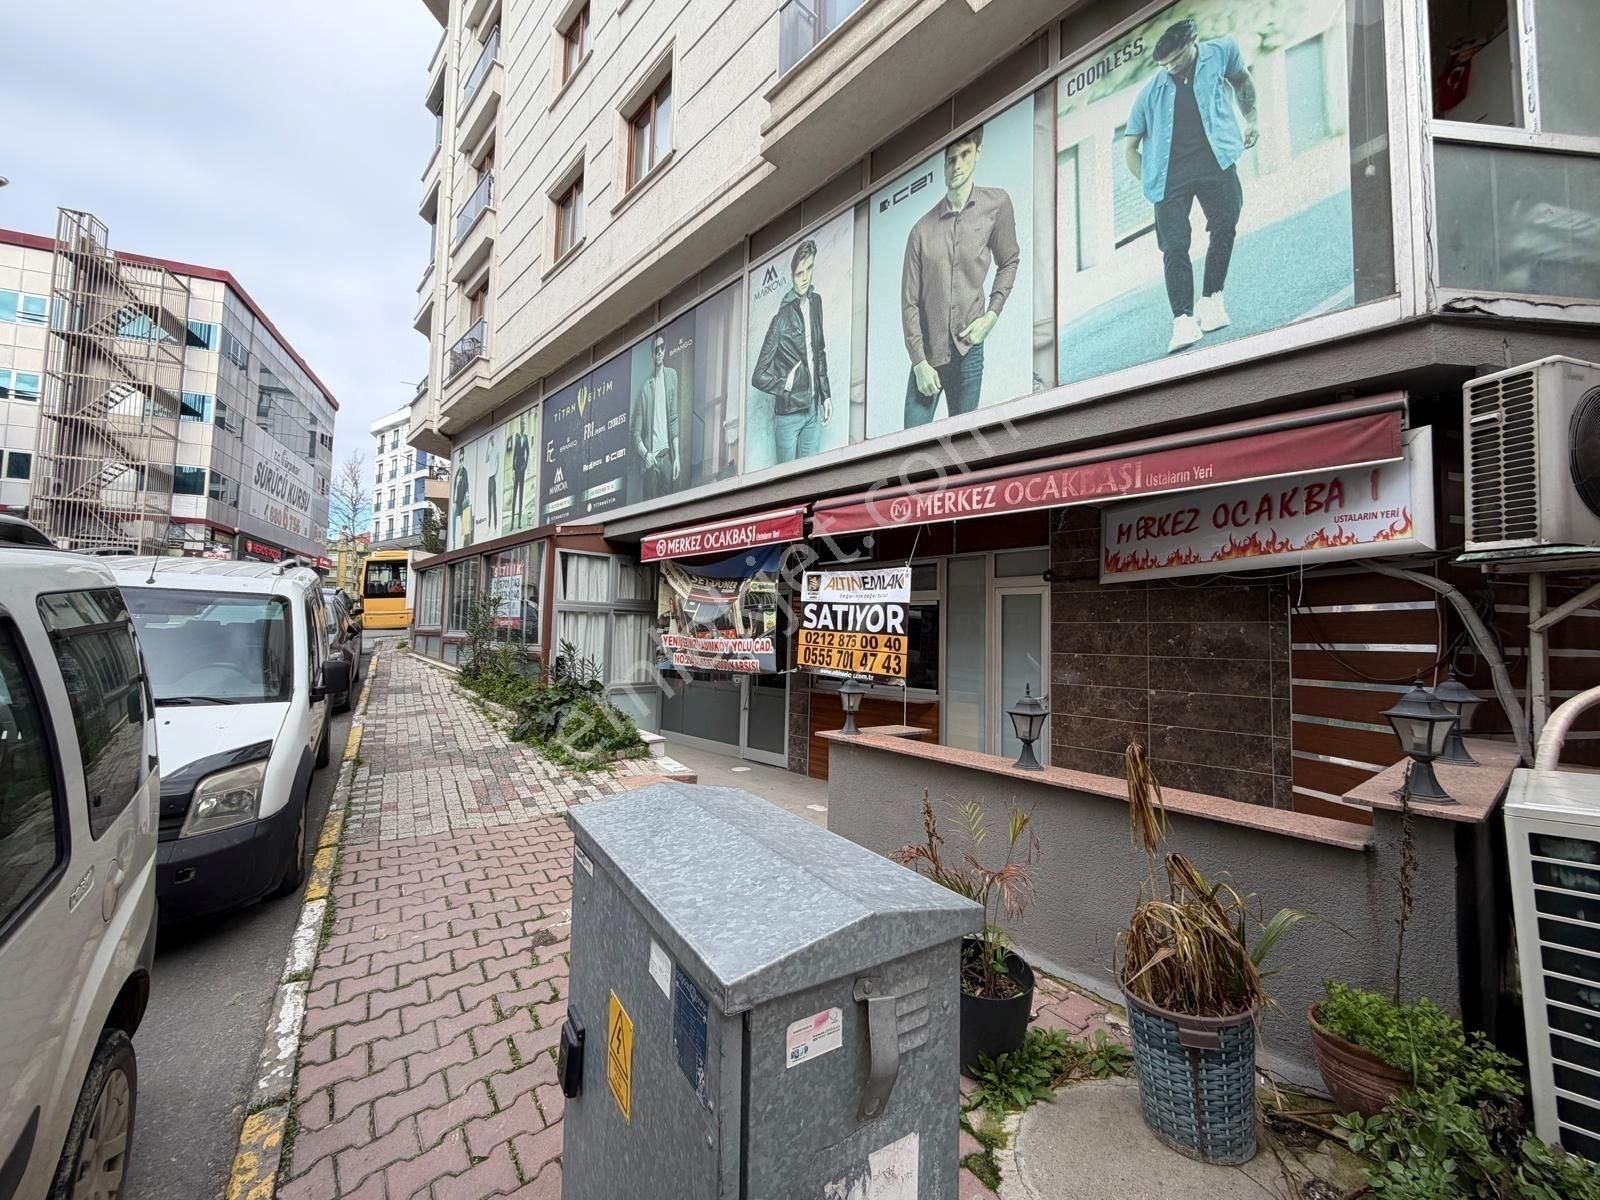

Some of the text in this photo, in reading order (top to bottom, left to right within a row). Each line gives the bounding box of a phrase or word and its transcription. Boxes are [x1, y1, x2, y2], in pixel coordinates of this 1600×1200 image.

[254, 461, 311, 512] SÜRÜCÜ KURSU
[915, 485, 996, 517] MERKEZ
[1004, 461, 1142, 505] OCAKBAŞI
[1145, 469, 1190, 487] Ustaların
[1193, 464, 1213, 479] Yeri
[1117, 508, 1200, 544] MERKEZ
[1334, 507, 1400, 523] USTALARIN YERİ
[667, 535, 701, 554] MERKEZ
[704, 525, 756, 549] OCAKBAŞI
[803, 603, 904, 634] SATIYOR
[732, 640, 753, 652] YOLU
[754, 639, 773, 653] CAD.
[805, 631, 901, 652] 0212 876 00 40
[804, 647, 901, 675] 0555 701 47 43
